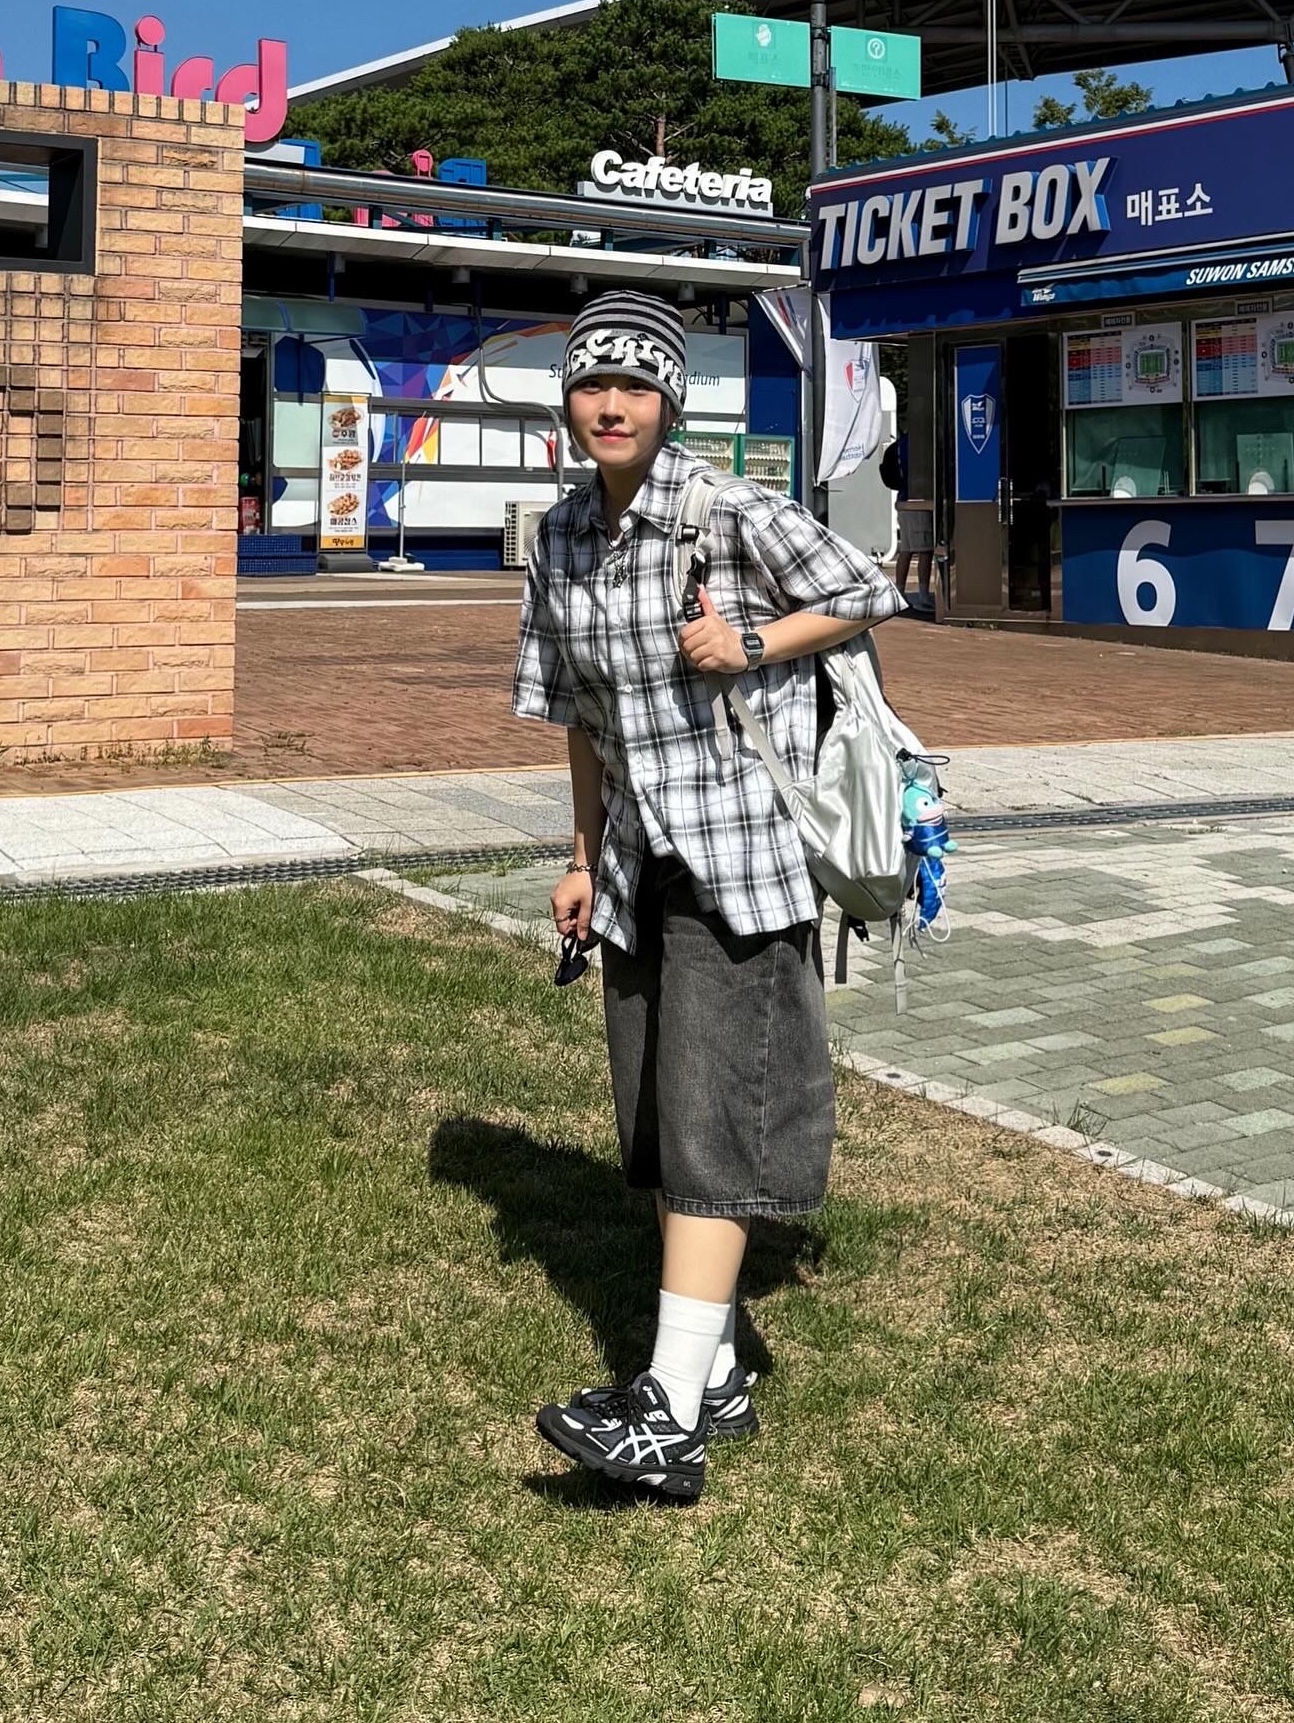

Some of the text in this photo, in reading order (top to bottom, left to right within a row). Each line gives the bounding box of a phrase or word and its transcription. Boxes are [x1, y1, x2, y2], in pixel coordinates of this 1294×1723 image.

[51, 5, 288, 142] Bird
[591, 149, 773, 205] Cafeteria
[818, 156, 1114, 270] TICKET BOX
[1126, 182, 1214, 227] 매표소
[1186, 262, 1248, 286] SUWON
[1117, 519, 1294, 631] 6 7
